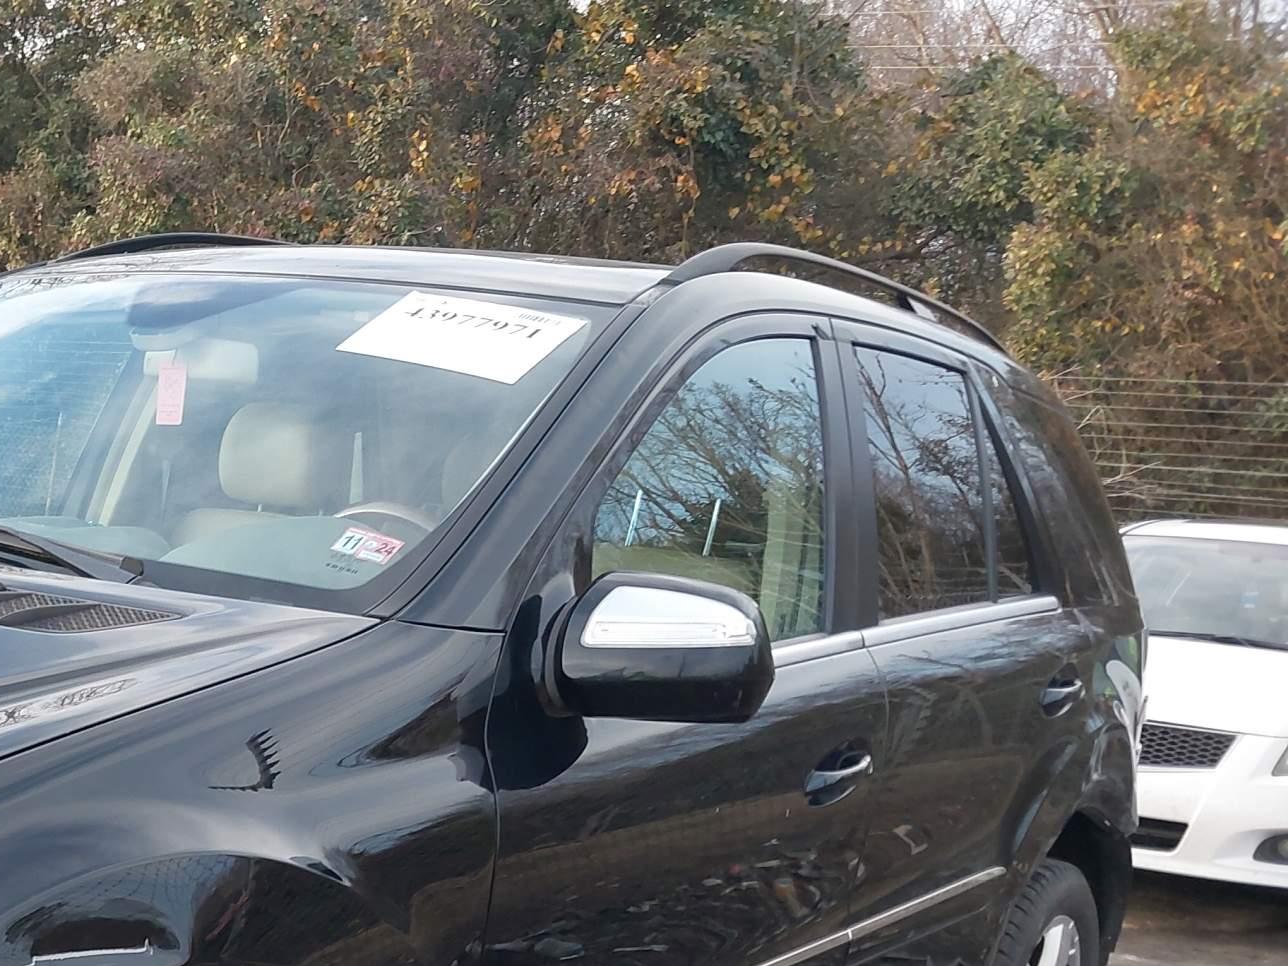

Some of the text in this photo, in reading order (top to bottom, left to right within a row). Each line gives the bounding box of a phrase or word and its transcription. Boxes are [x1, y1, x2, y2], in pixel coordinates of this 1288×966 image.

[404, 306, 541, 339] 43977971
[342, 534, 396, 557] 11 24
